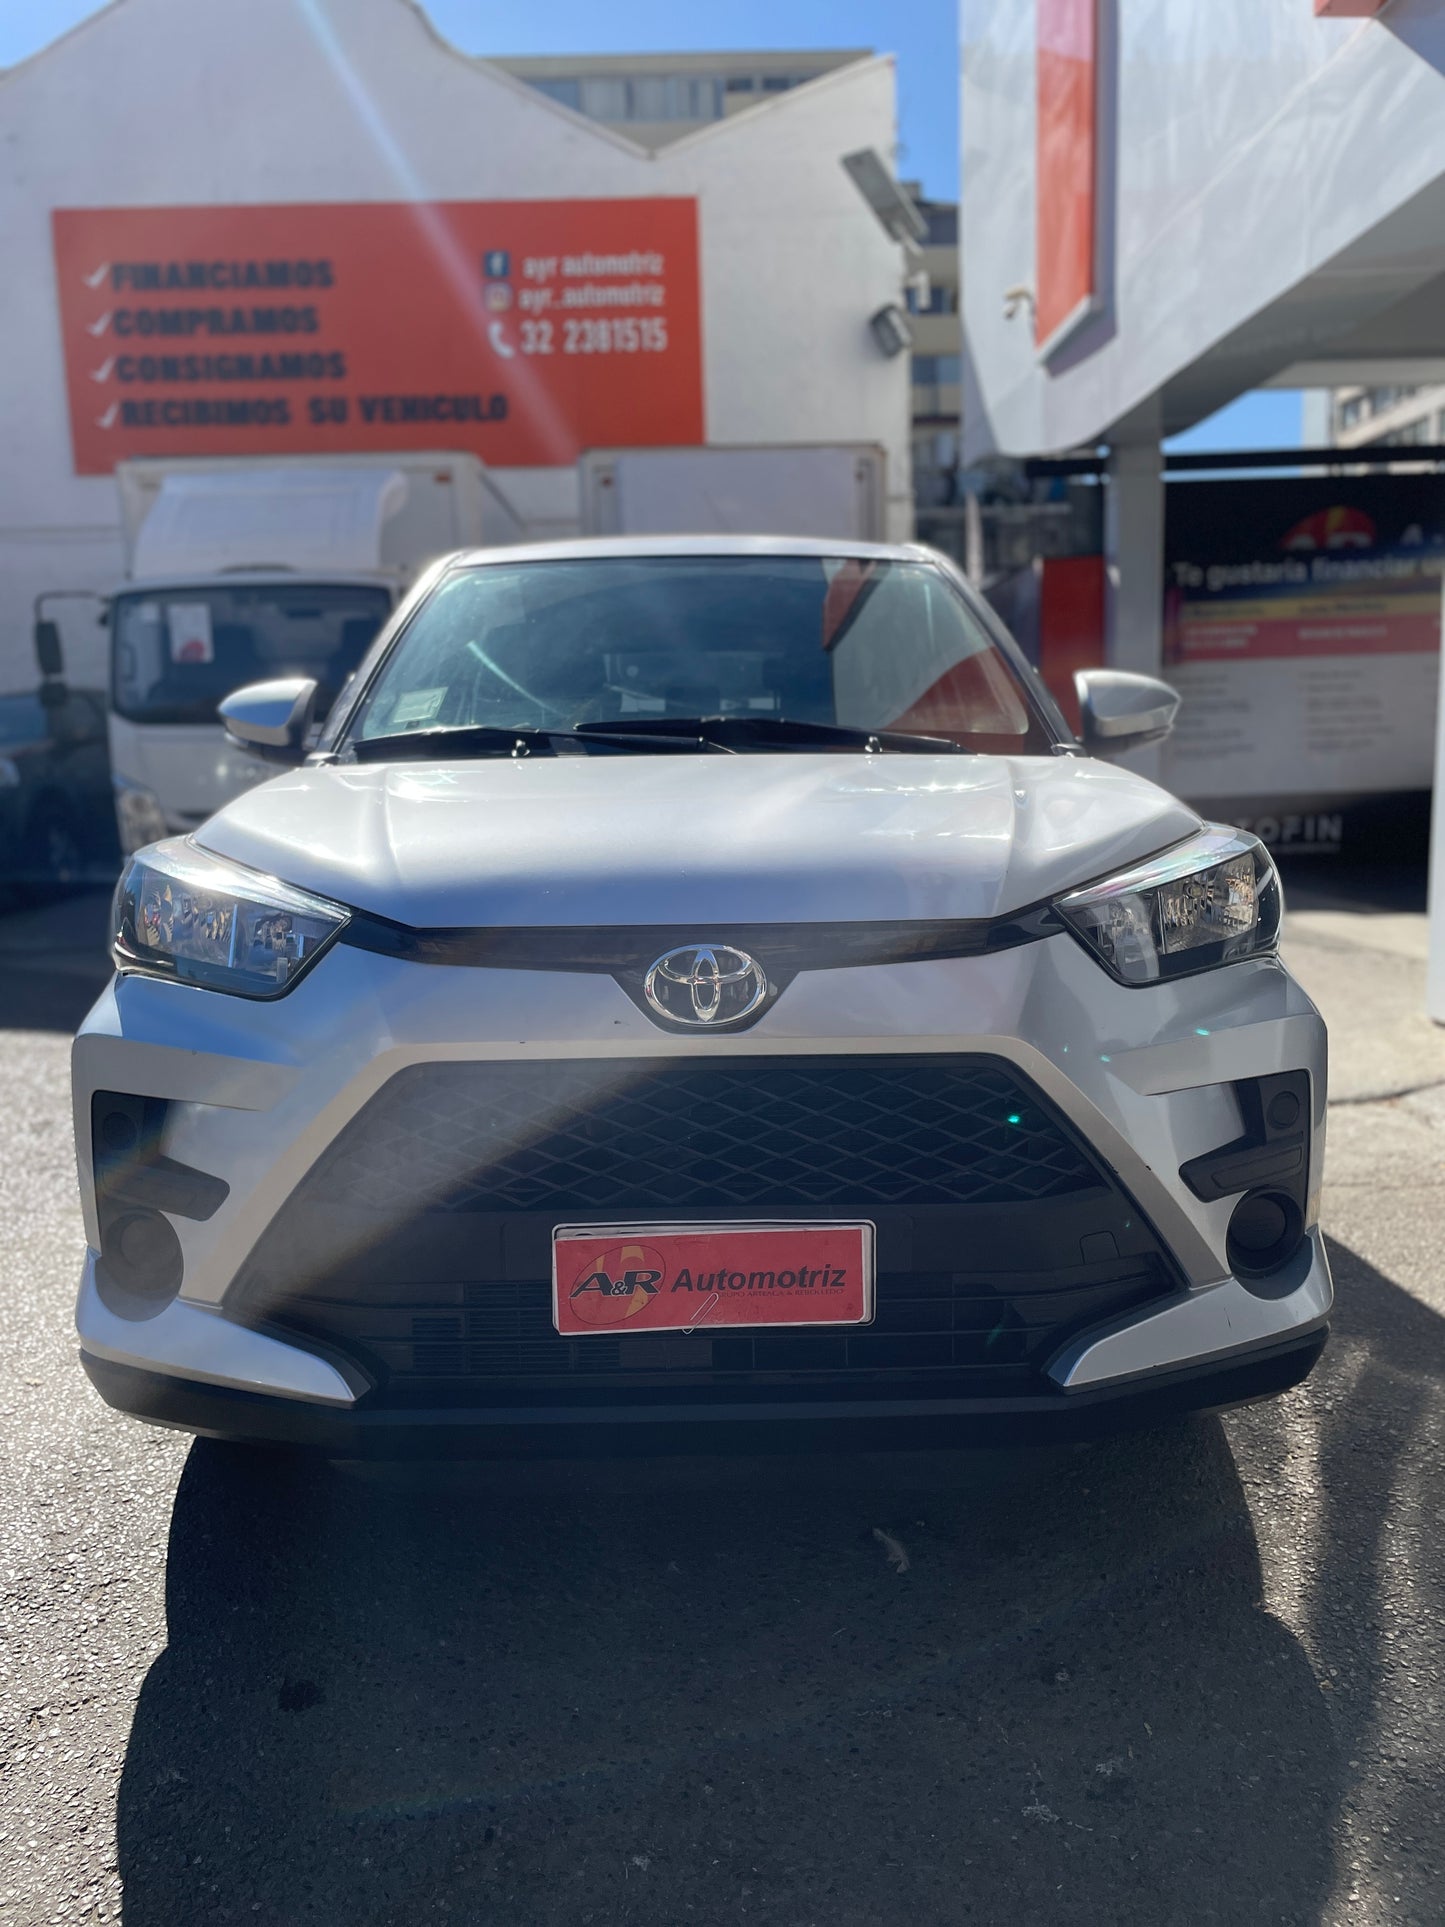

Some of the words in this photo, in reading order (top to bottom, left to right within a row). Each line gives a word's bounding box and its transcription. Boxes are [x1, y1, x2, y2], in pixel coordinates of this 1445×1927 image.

[111, 260, 334, 290] FINANCIAMOS
[113, 306, 319, 336] COMPRAMOS
[520, 319, 554, 354] 32
[117, 353, 346, 383] CONSIGNAMOS
[121, 397, 290, 428] RECIBIMOS
[308, 395, 347, 425] SU
[358, 393, 508, 423] VEHICULO
[1172, 560, 1203, 587] Te
[1311, 551, 1417, 582] financiar
[568, 1269, 662, 1299] A&R
[671, 1263, 847, 1293] Automotriz
